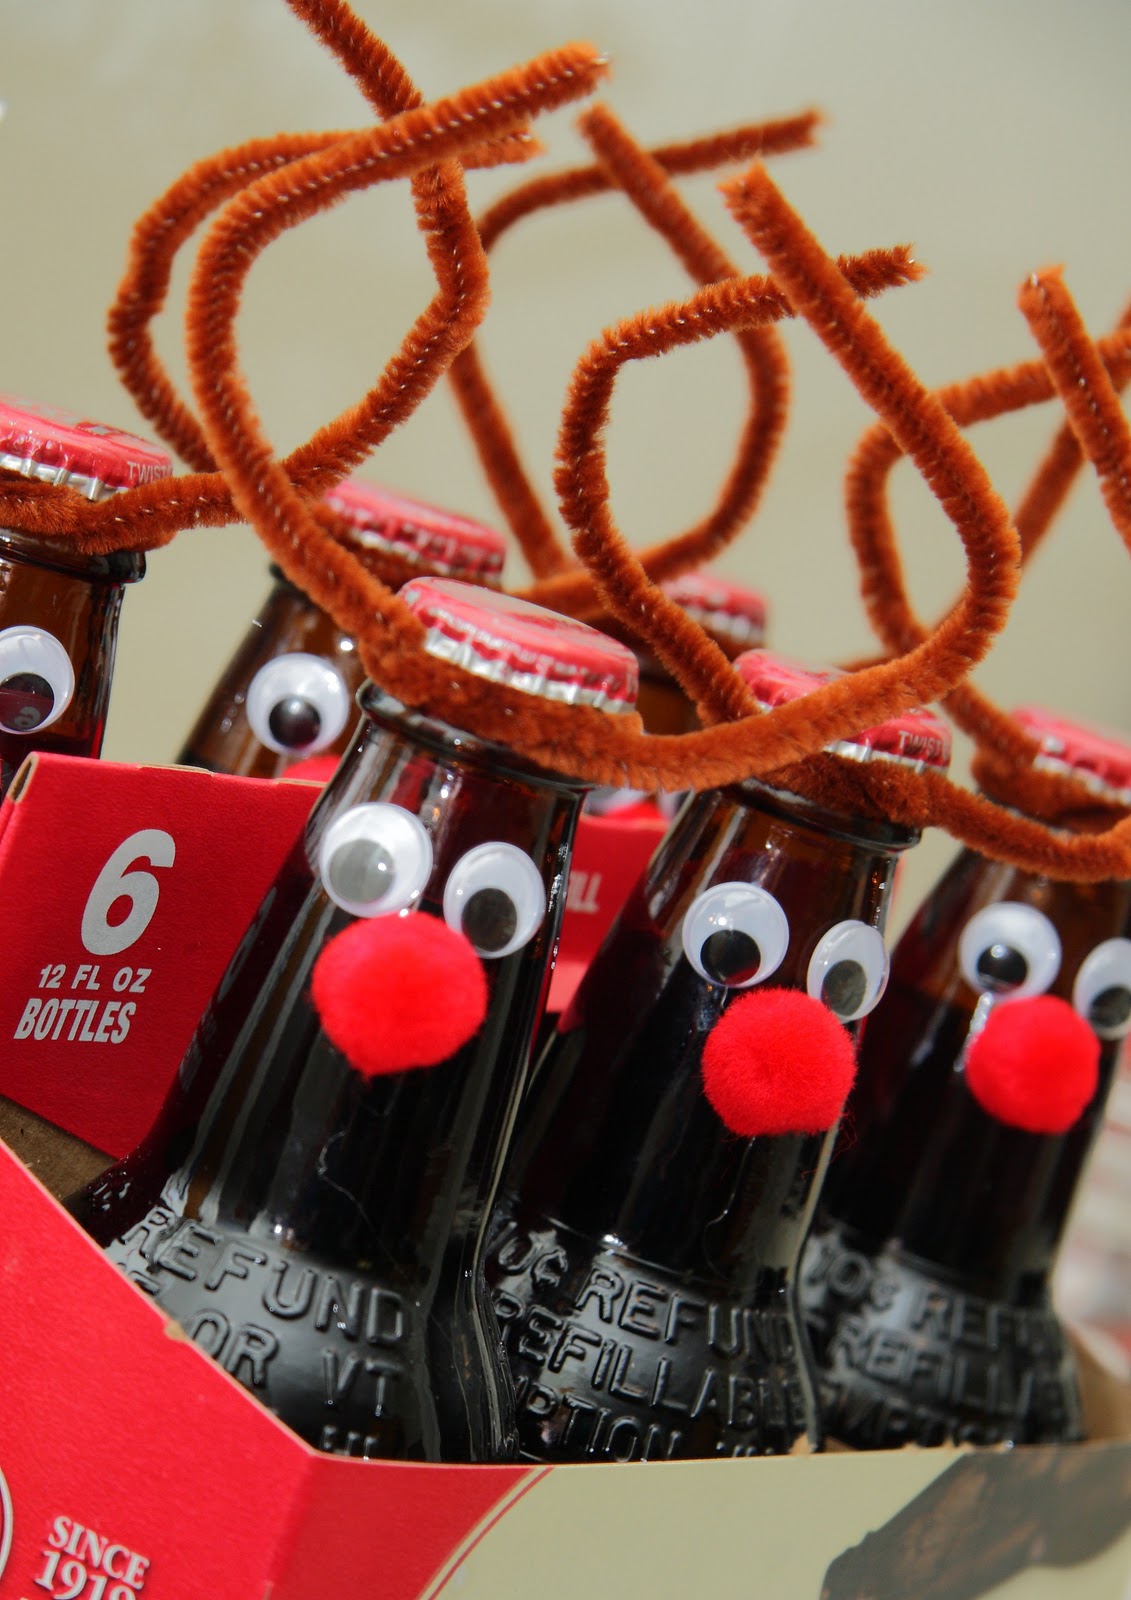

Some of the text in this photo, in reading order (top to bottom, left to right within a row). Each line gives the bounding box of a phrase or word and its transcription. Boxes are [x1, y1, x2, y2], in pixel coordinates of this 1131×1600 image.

[81, 828, 176, 956] 6
[13, 998, 137, 1044] BOTTLES
[38, 963, 152, 993] 12 FL OZ
[120, 1206, 404, 1346] REFUND
[193, 1307, 403, 1418] OR VT
[48, 1515, 150, 1590] SINCE
